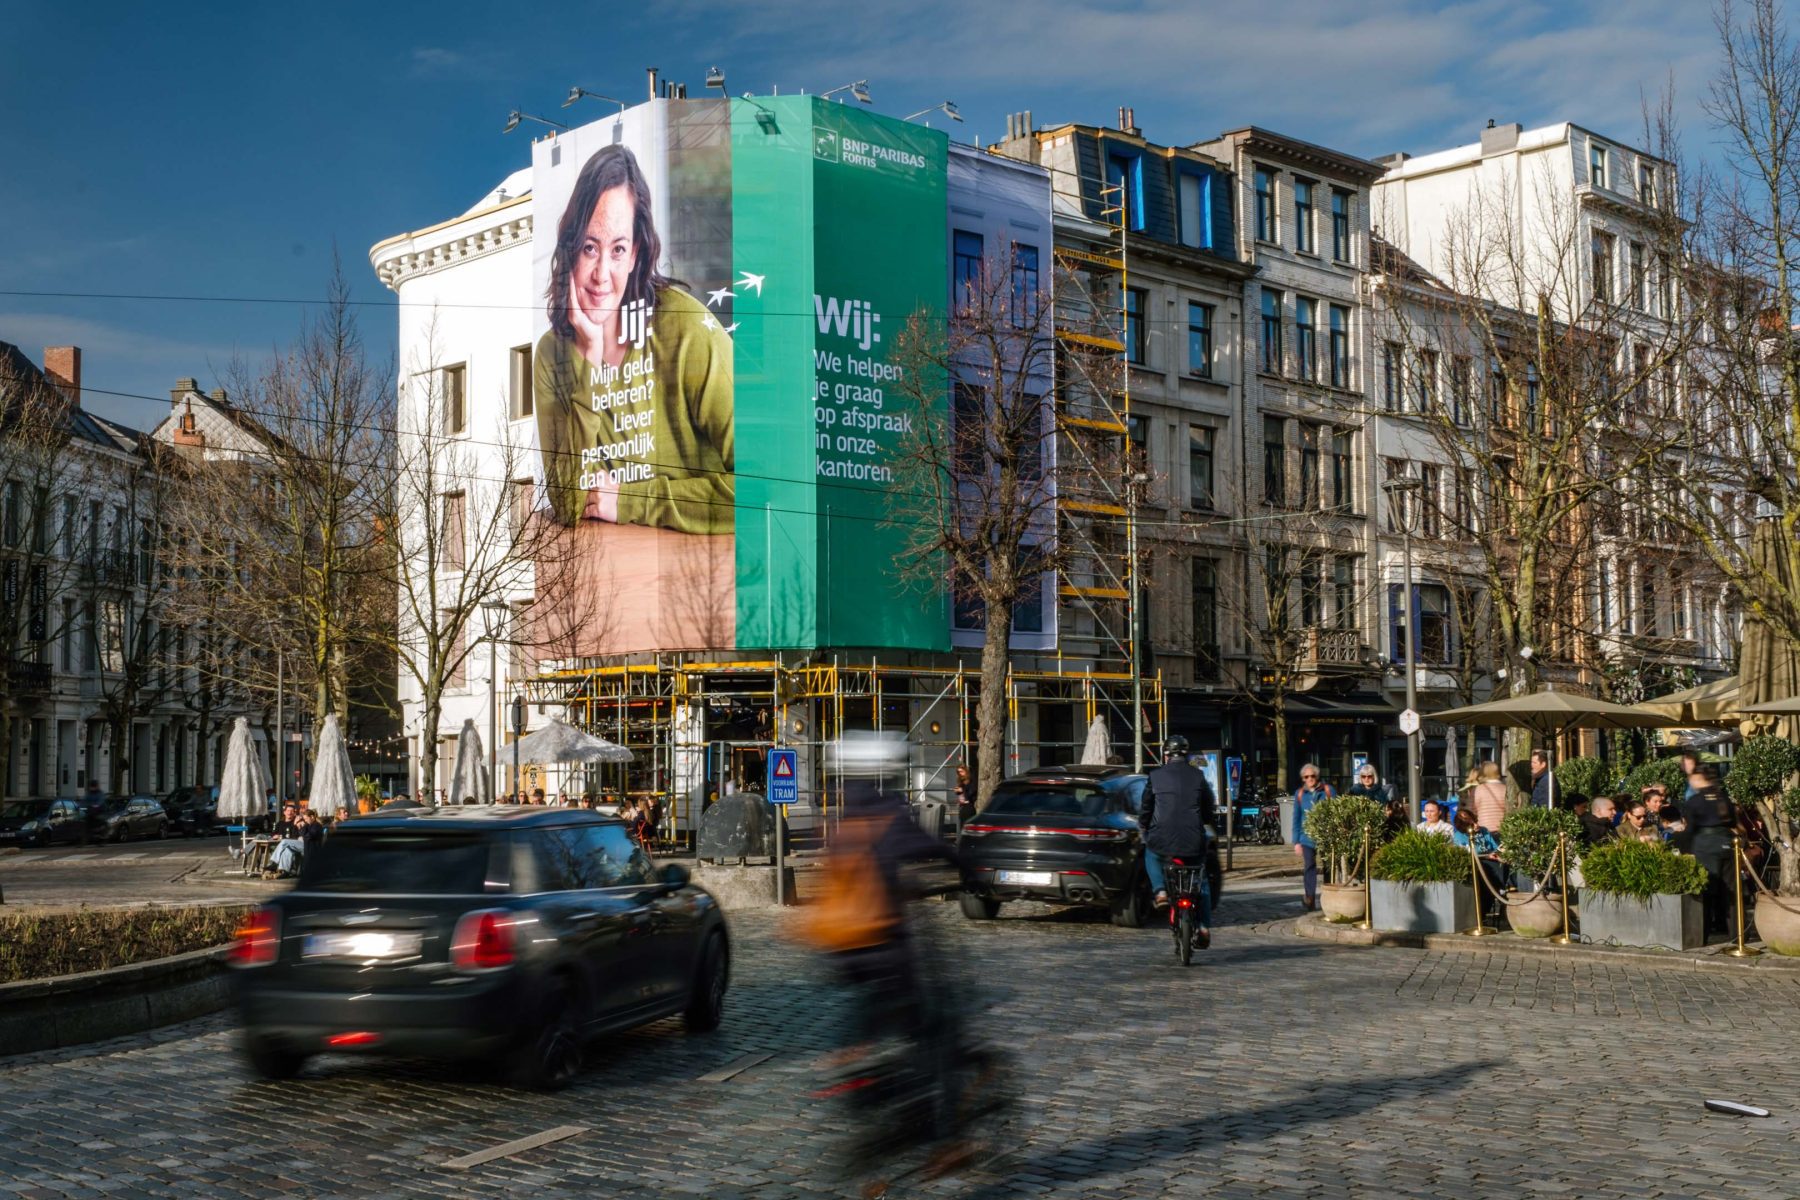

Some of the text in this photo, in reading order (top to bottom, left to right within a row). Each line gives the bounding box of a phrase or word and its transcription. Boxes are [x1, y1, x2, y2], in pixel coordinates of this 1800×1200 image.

[842, 138, 926, 168] BNP PARIBAS
[842, 152, 877, 168] FORTIS
[618, 298, 653, 349] Jij:
[813, 294, 881, 351] Wij:
[590, 352, 654, 388] Mijn geld
[813, 349, 903, 384] We helpen
[592, 379, 654, 412] beheren?
[811, 376, 883, 410] je graag
[614, 409, 655, 433] Liever
[814, 406, 912, 434] op afspraak
[581, 431, 655, 470] persoonlijk
[815, 429, 876, 455] in onze
[580, 461, 655, 490] dan online.
[816, 454, 895, 483] kantoren.
[774, 788, 795, 799] TRAM
